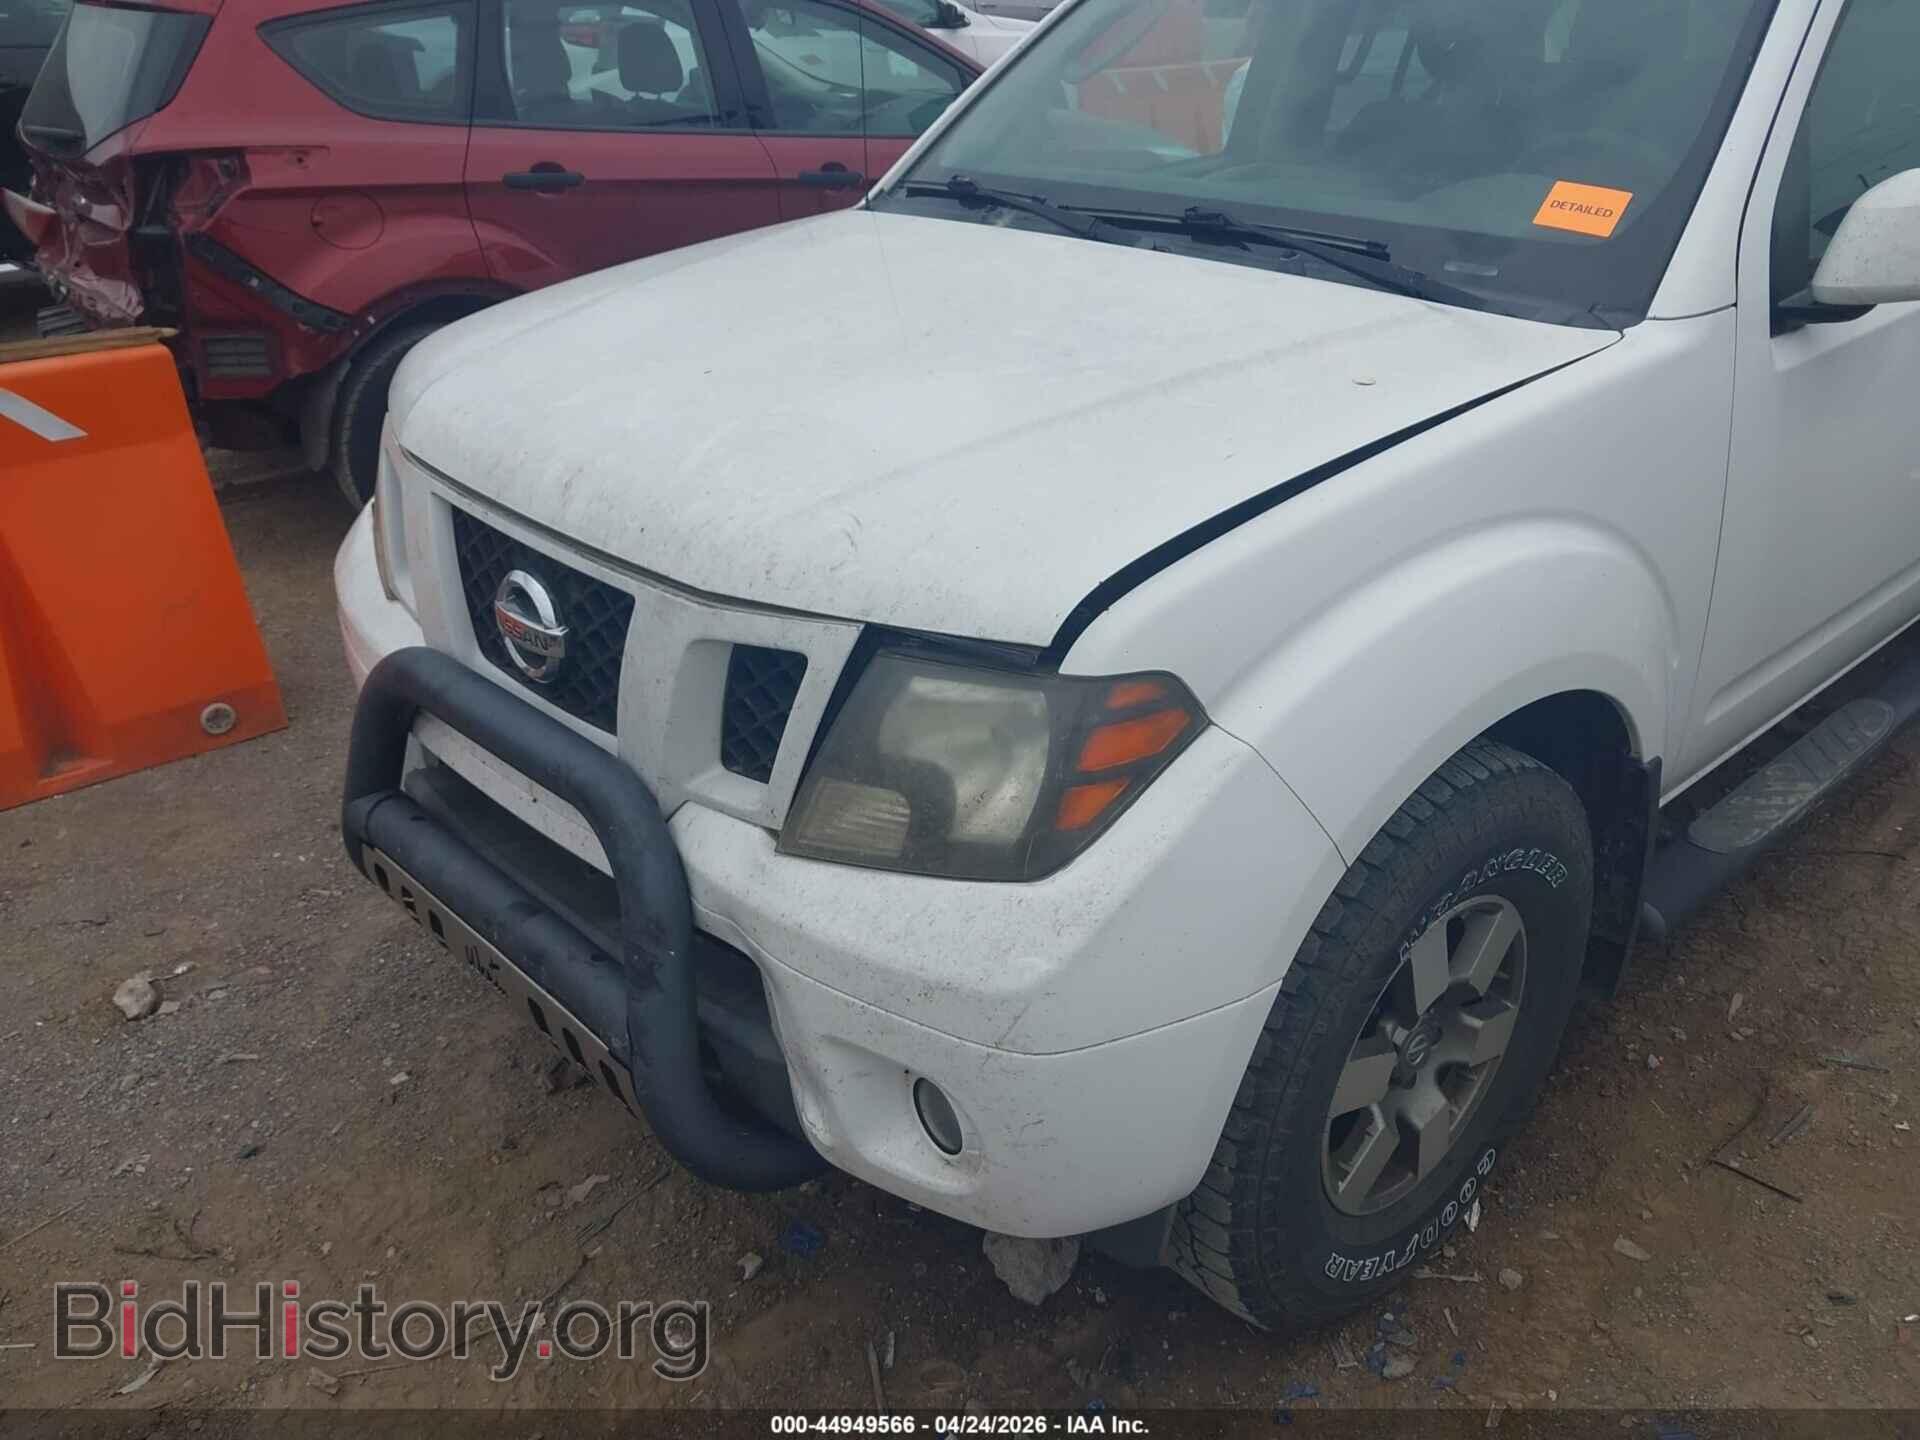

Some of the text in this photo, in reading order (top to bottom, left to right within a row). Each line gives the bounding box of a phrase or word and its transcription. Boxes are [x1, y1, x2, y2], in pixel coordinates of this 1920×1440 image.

[1549, 199, 1614, 218] DETAILED
[497, 608, 550, 652] SSAN
[1324, 1148, 1496, 1282] GOODYEAR
